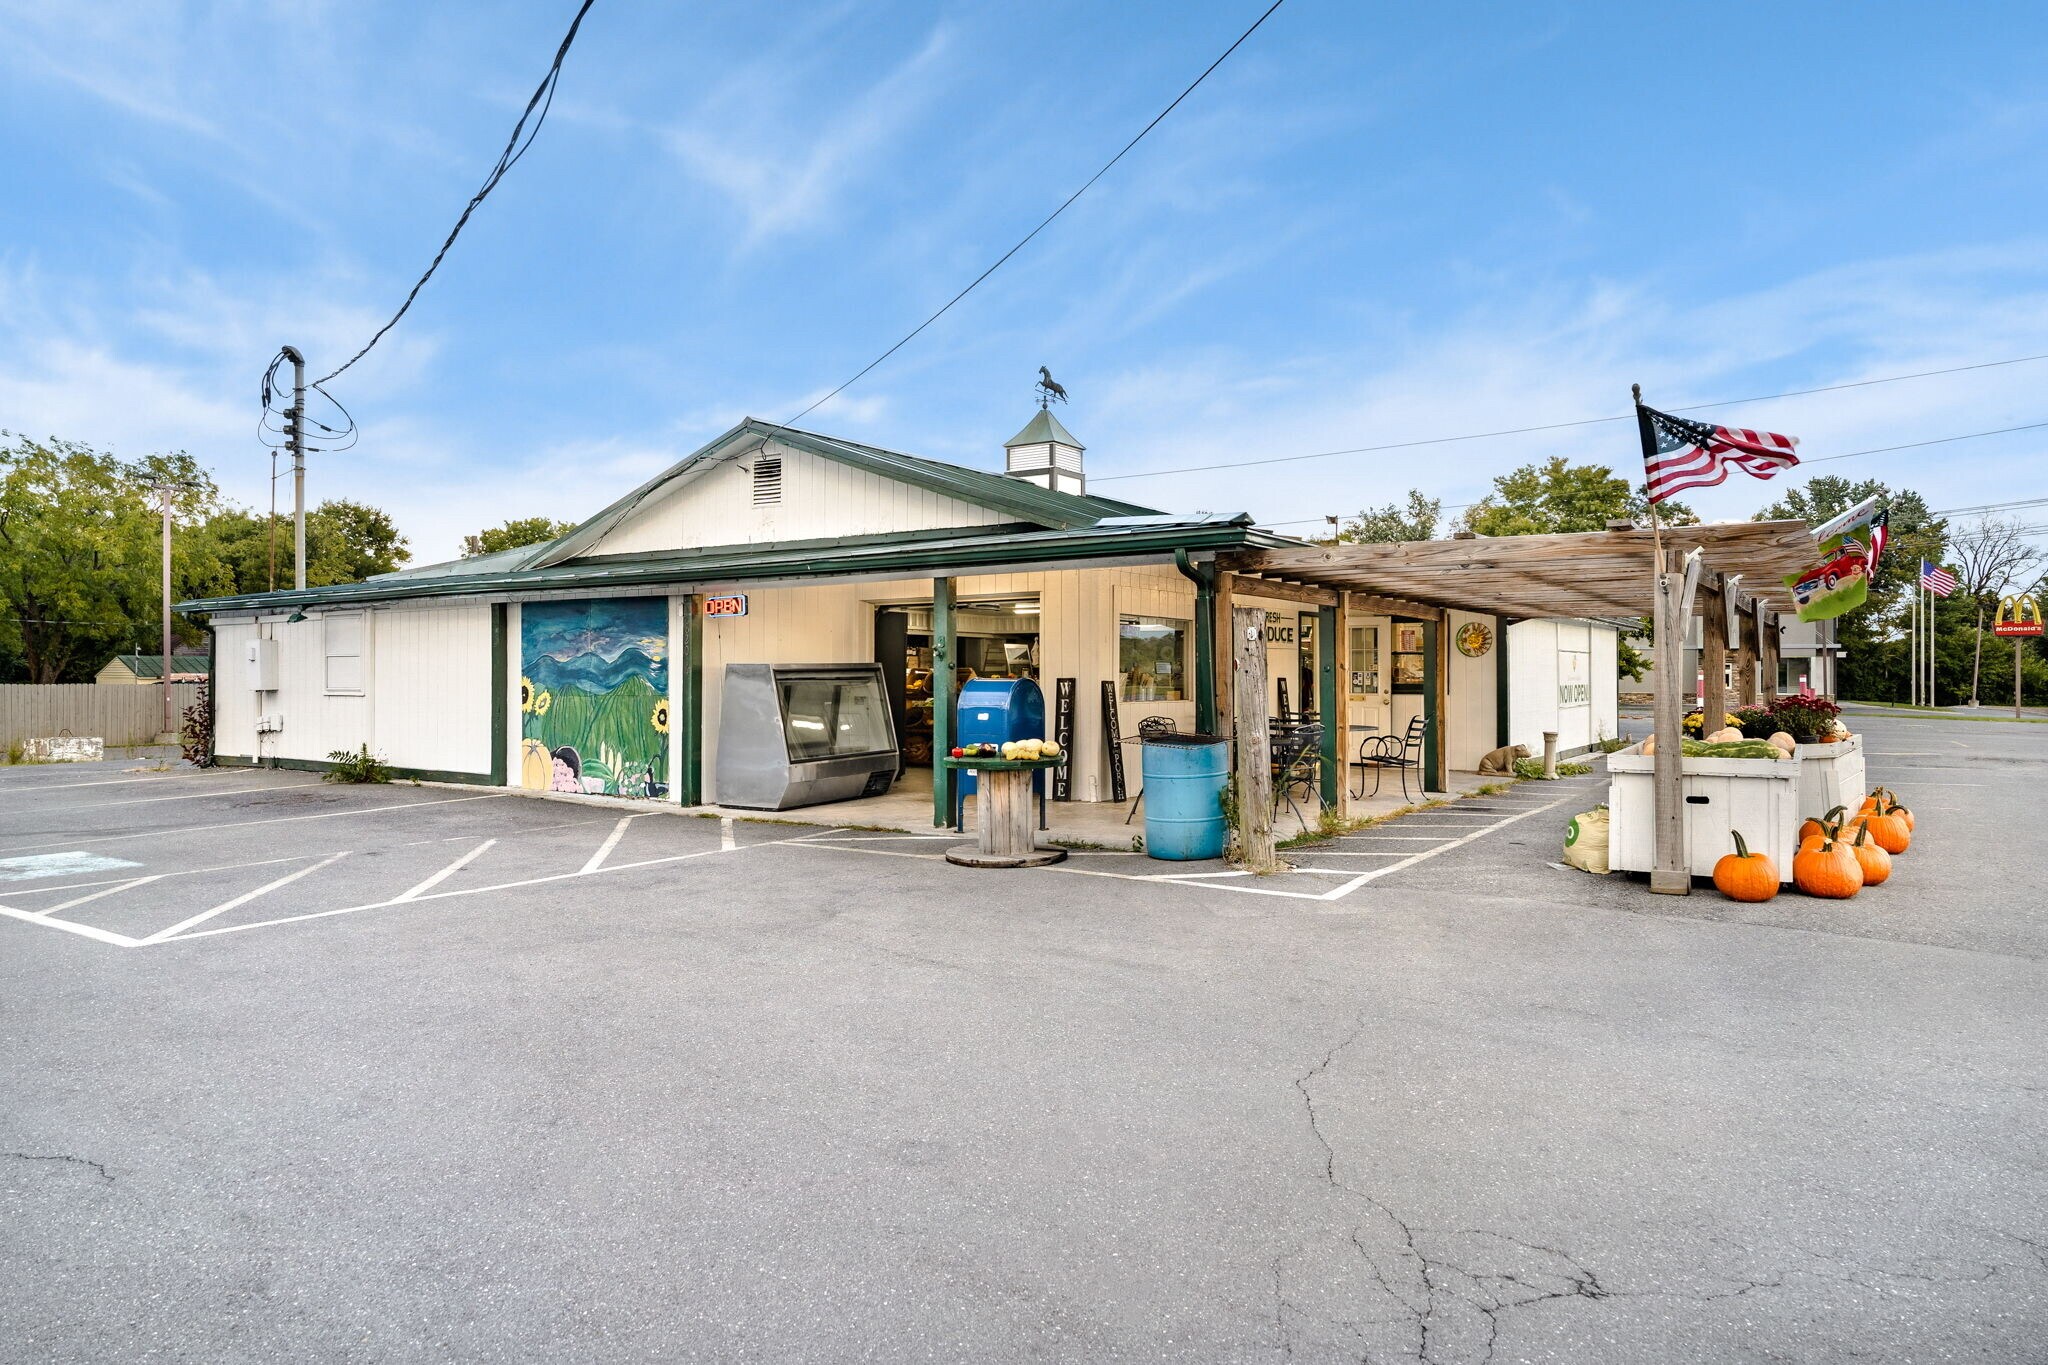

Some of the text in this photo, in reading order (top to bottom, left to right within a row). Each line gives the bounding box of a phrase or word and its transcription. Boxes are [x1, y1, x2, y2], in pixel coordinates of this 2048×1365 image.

[704, 598, 741, 614] OPEN
[1265, 611, 1281, 624] RESH
[1266, 626, 1294, 642] DUCE
[1560, 685, 1573, 704] NOW
[1105, 683, 1119, 748] WELCOME
[1114, 754, 1125, 800] PORCH
